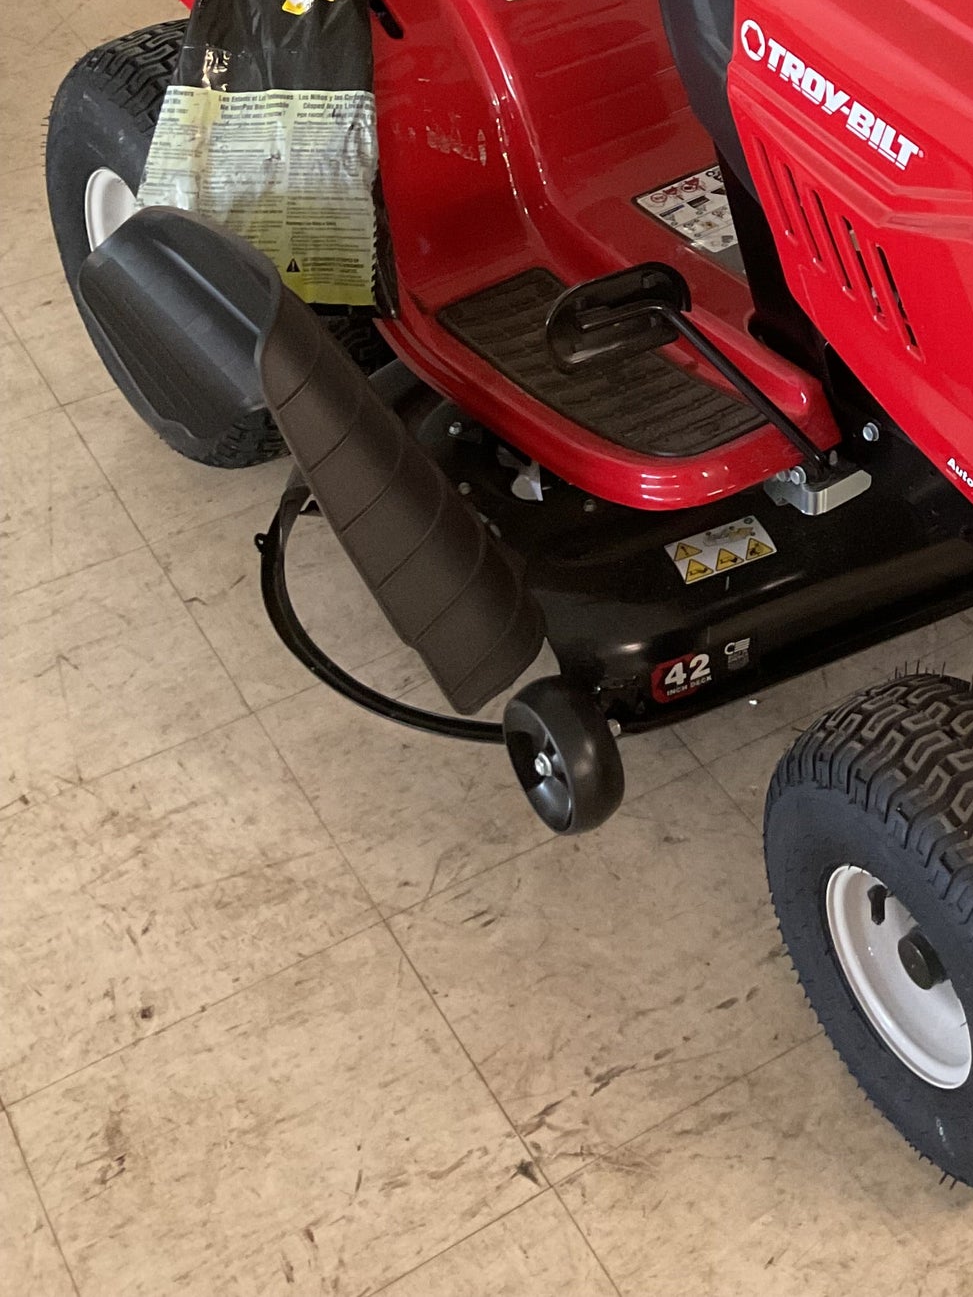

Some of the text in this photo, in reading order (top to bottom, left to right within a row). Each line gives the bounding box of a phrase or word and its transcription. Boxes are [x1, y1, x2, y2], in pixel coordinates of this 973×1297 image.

[767, 37, 920, 171] TROY-BILT
[665, 653, 711, 685] 42
[667, 675, 712, 696] INCH DECK
